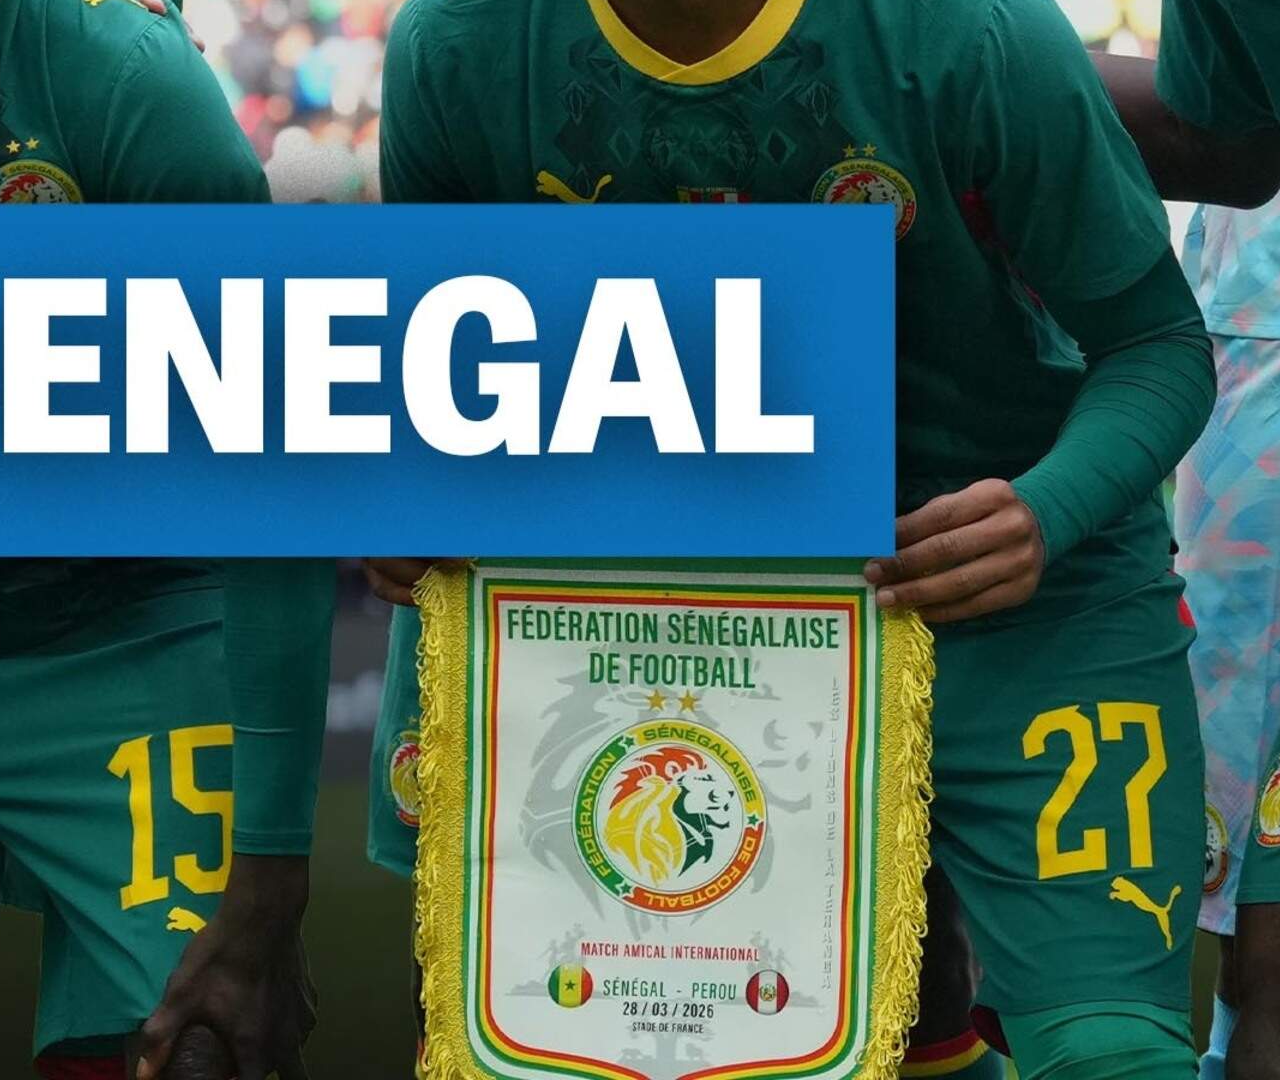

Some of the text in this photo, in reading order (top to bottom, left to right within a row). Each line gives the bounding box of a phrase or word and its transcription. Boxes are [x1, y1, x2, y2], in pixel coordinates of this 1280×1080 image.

[507, 605, 839, 649] FÉDÉRATION SÉNÉGALAISE
[589, 653, 756, 688] DE FOOTBALL
[577, 723, 757, 878] FÉDÉRATION SÉNÉGALAISE
[1022, 701, 1167, 880] 27
[107, 724, 234, 910] 15
[643, 838, 757, 909] DE FOOTBALL
[580, 942, 760, 962] MATCH AMICAL INTERNATIONAL
[602, 976, 667, 998] SÉNÉGAL
[691, 982, 737, 1000] PEROU
[622, 1001, 638, 1017] 28
[651, 1002, 667, 1017] 03
[682, 1003, 714, 1019] 2026
[632, 1021, 704, 1034] STADE DE FRANCE
